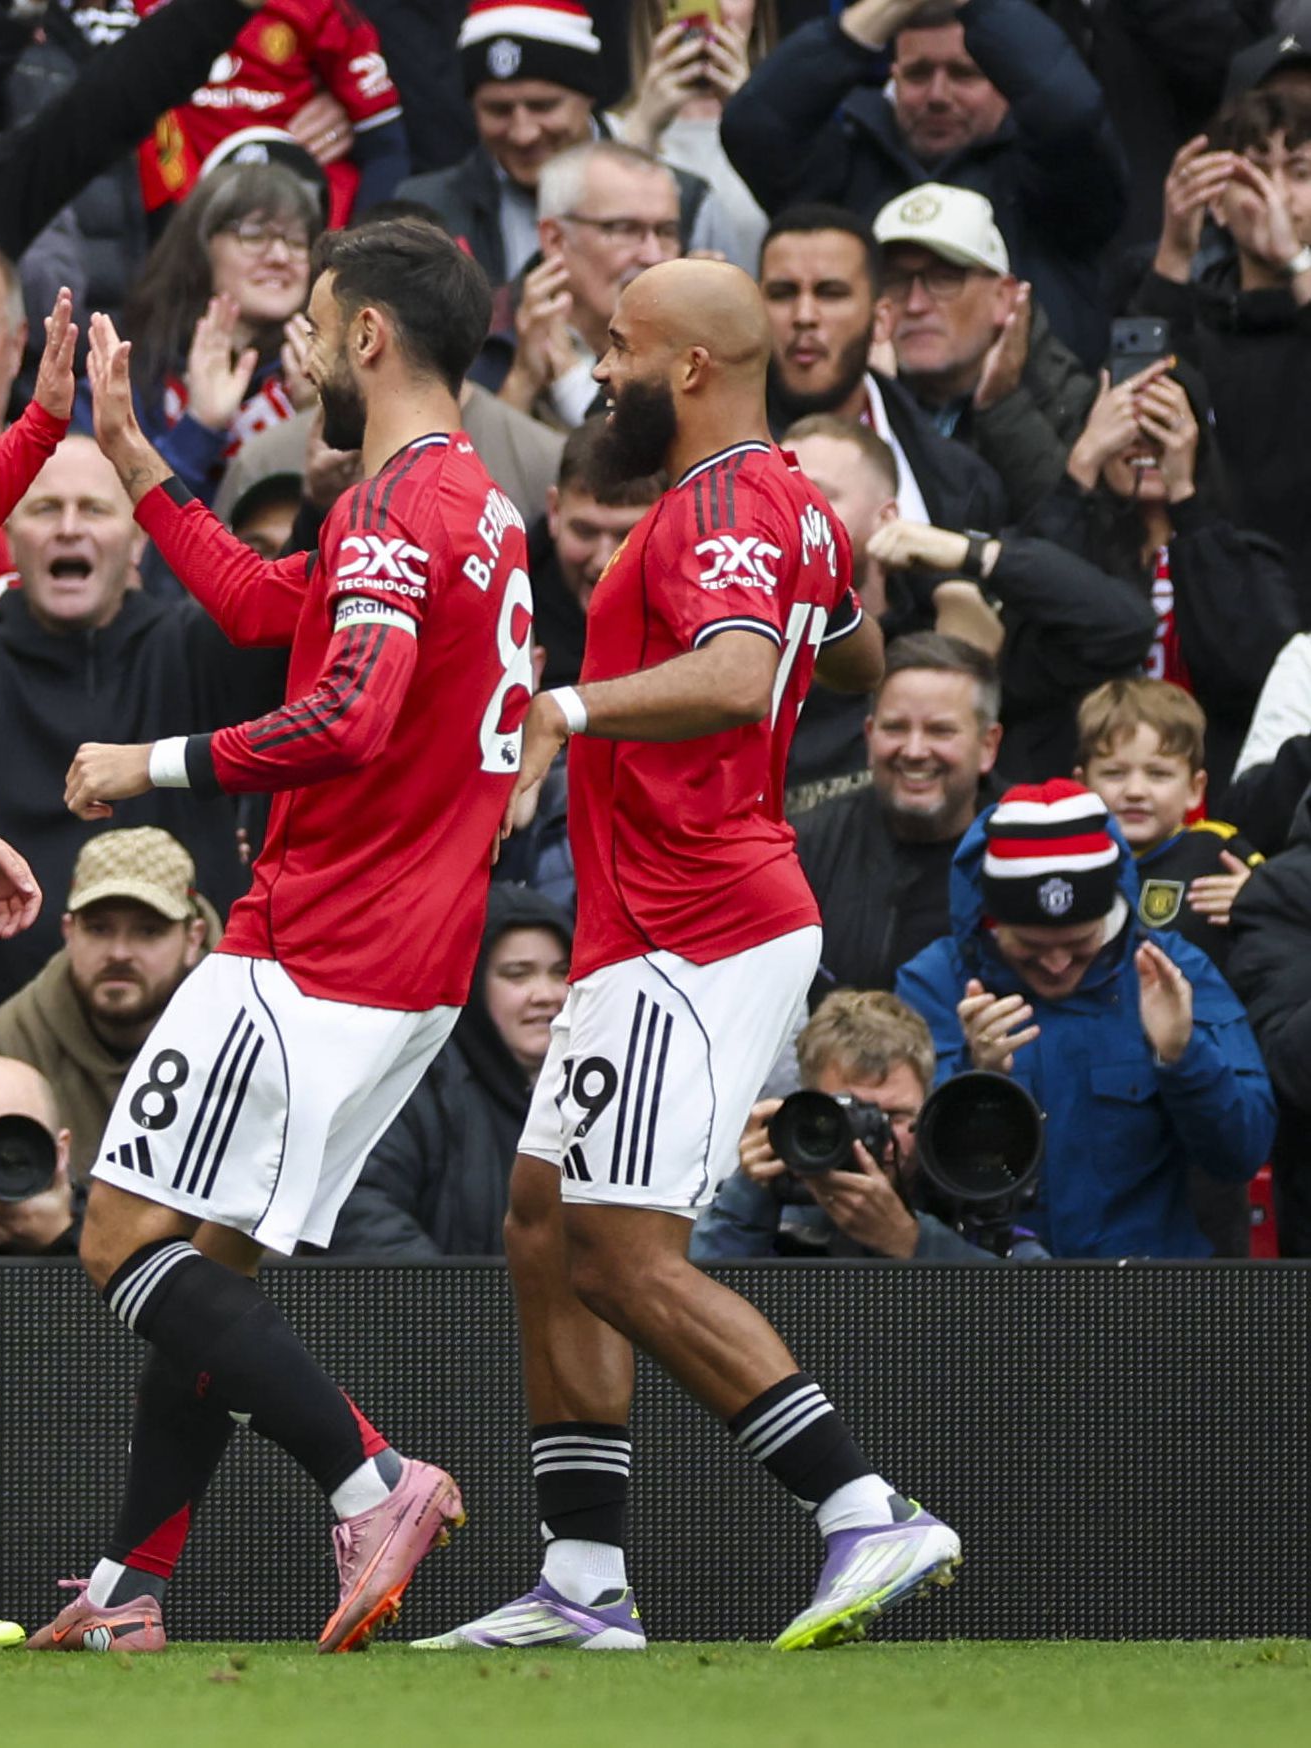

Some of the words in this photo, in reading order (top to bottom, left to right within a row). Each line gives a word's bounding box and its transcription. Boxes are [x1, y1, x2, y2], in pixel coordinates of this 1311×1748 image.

[337, 601, 395, 621] aptain
[479, 567, 533, 773] 8
[129, 1048, 190, 1131] 8
